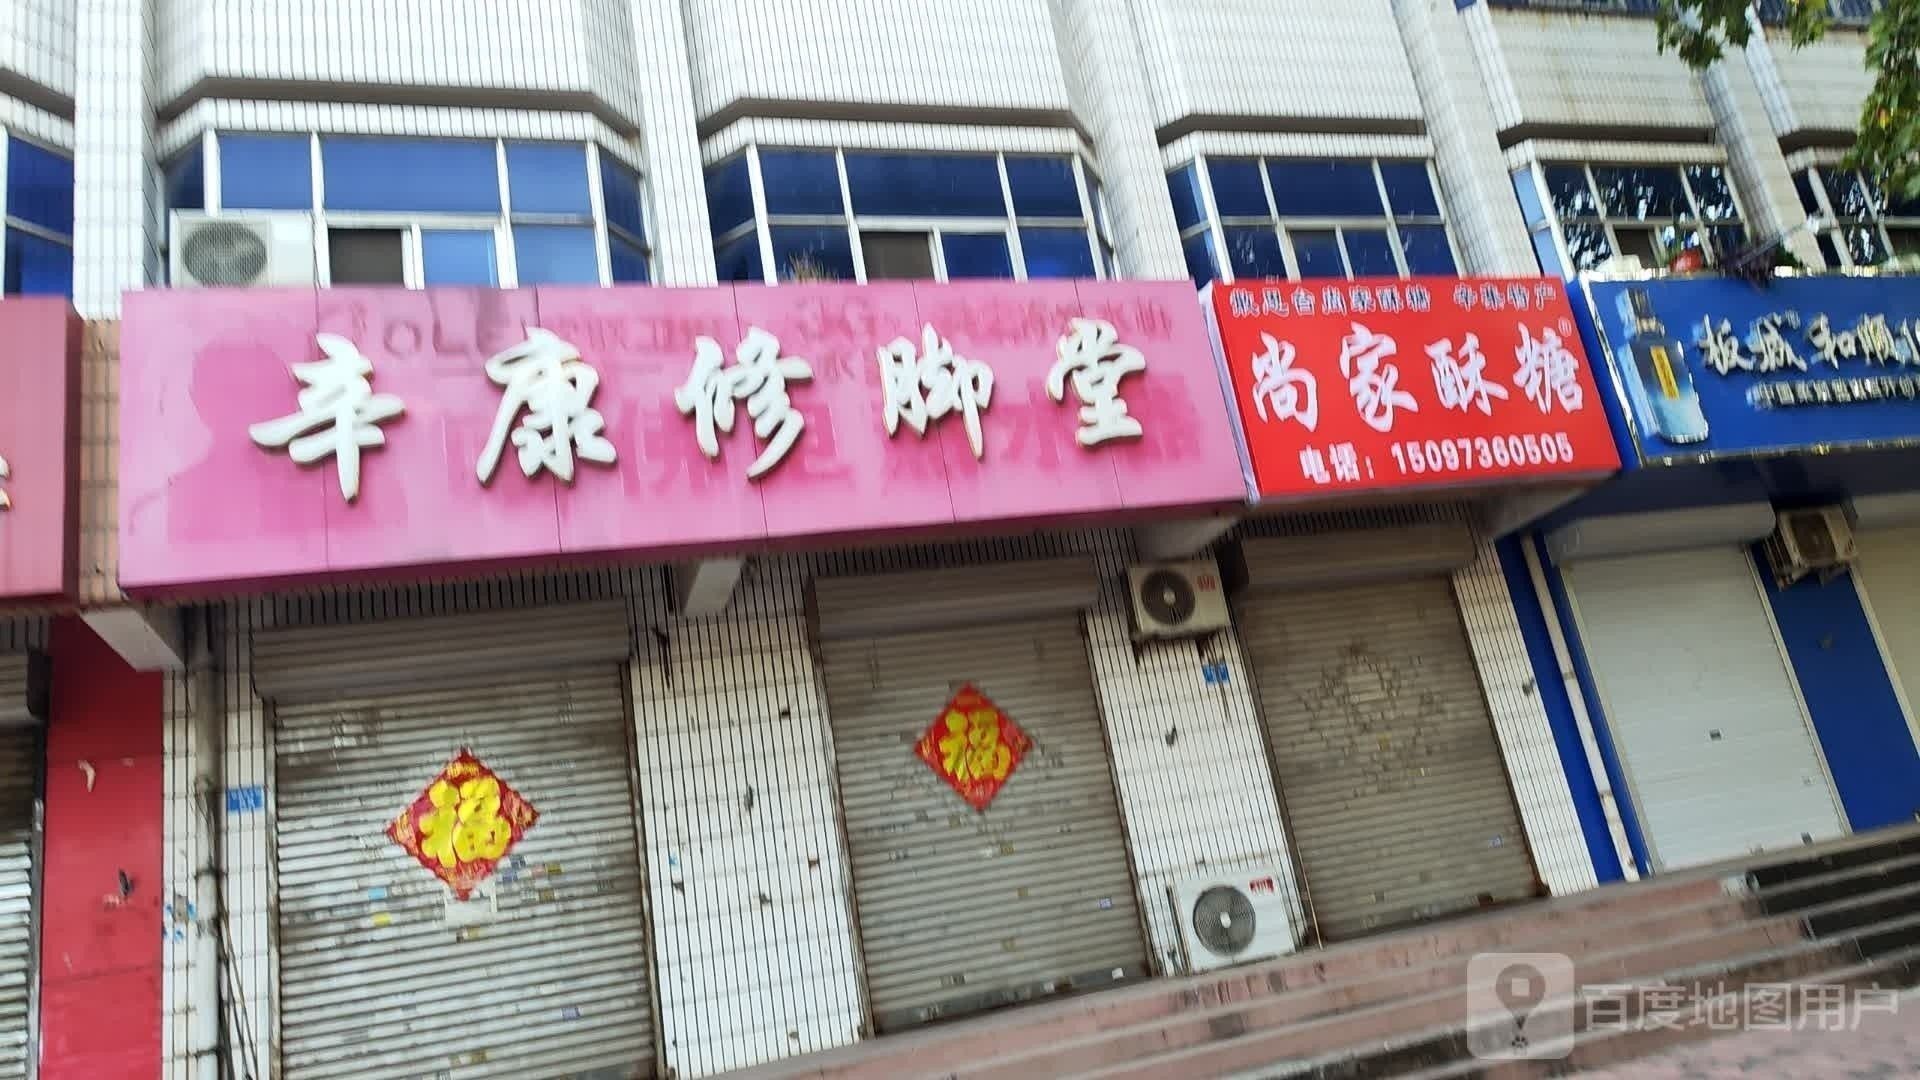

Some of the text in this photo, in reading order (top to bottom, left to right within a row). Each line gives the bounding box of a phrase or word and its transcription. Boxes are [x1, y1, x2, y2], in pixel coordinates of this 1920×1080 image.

[1251, 321, 1585, 433] 尚家酥糖
[1698, 310, 1920, 376] 板城和顺
[249, 317, 1147, 504] 辛康修脚堂
[939, 709, 1010, 782] 福
[419, 776, 511, 868] 福
